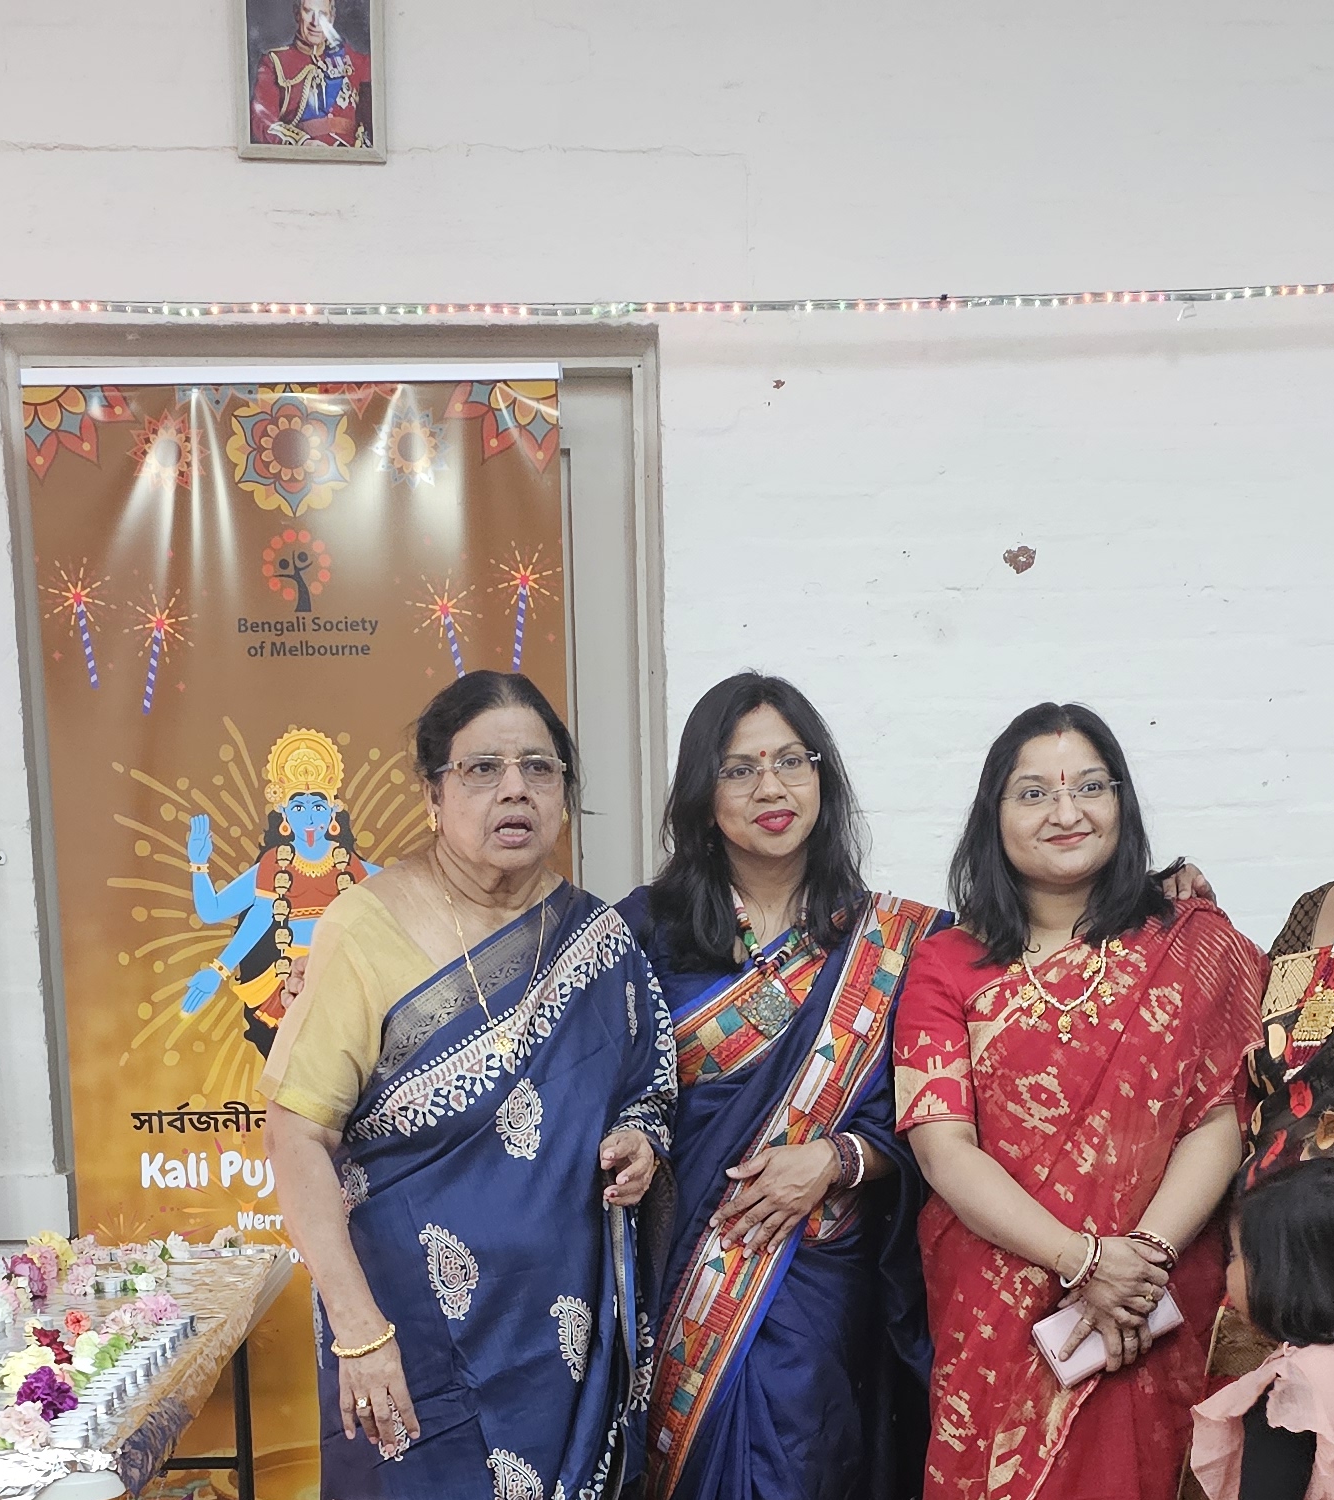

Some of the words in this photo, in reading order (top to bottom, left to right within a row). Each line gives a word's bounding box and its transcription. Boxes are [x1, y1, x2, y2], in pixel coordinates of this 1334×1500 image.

[238, 616, 307, 636] Bengali
[311, 616, 378, 635] Society
[247, 641, 266, 657] of
[270, 640, 370, 657] Melbourne
[141, 1152, 209, 1189] Kali
